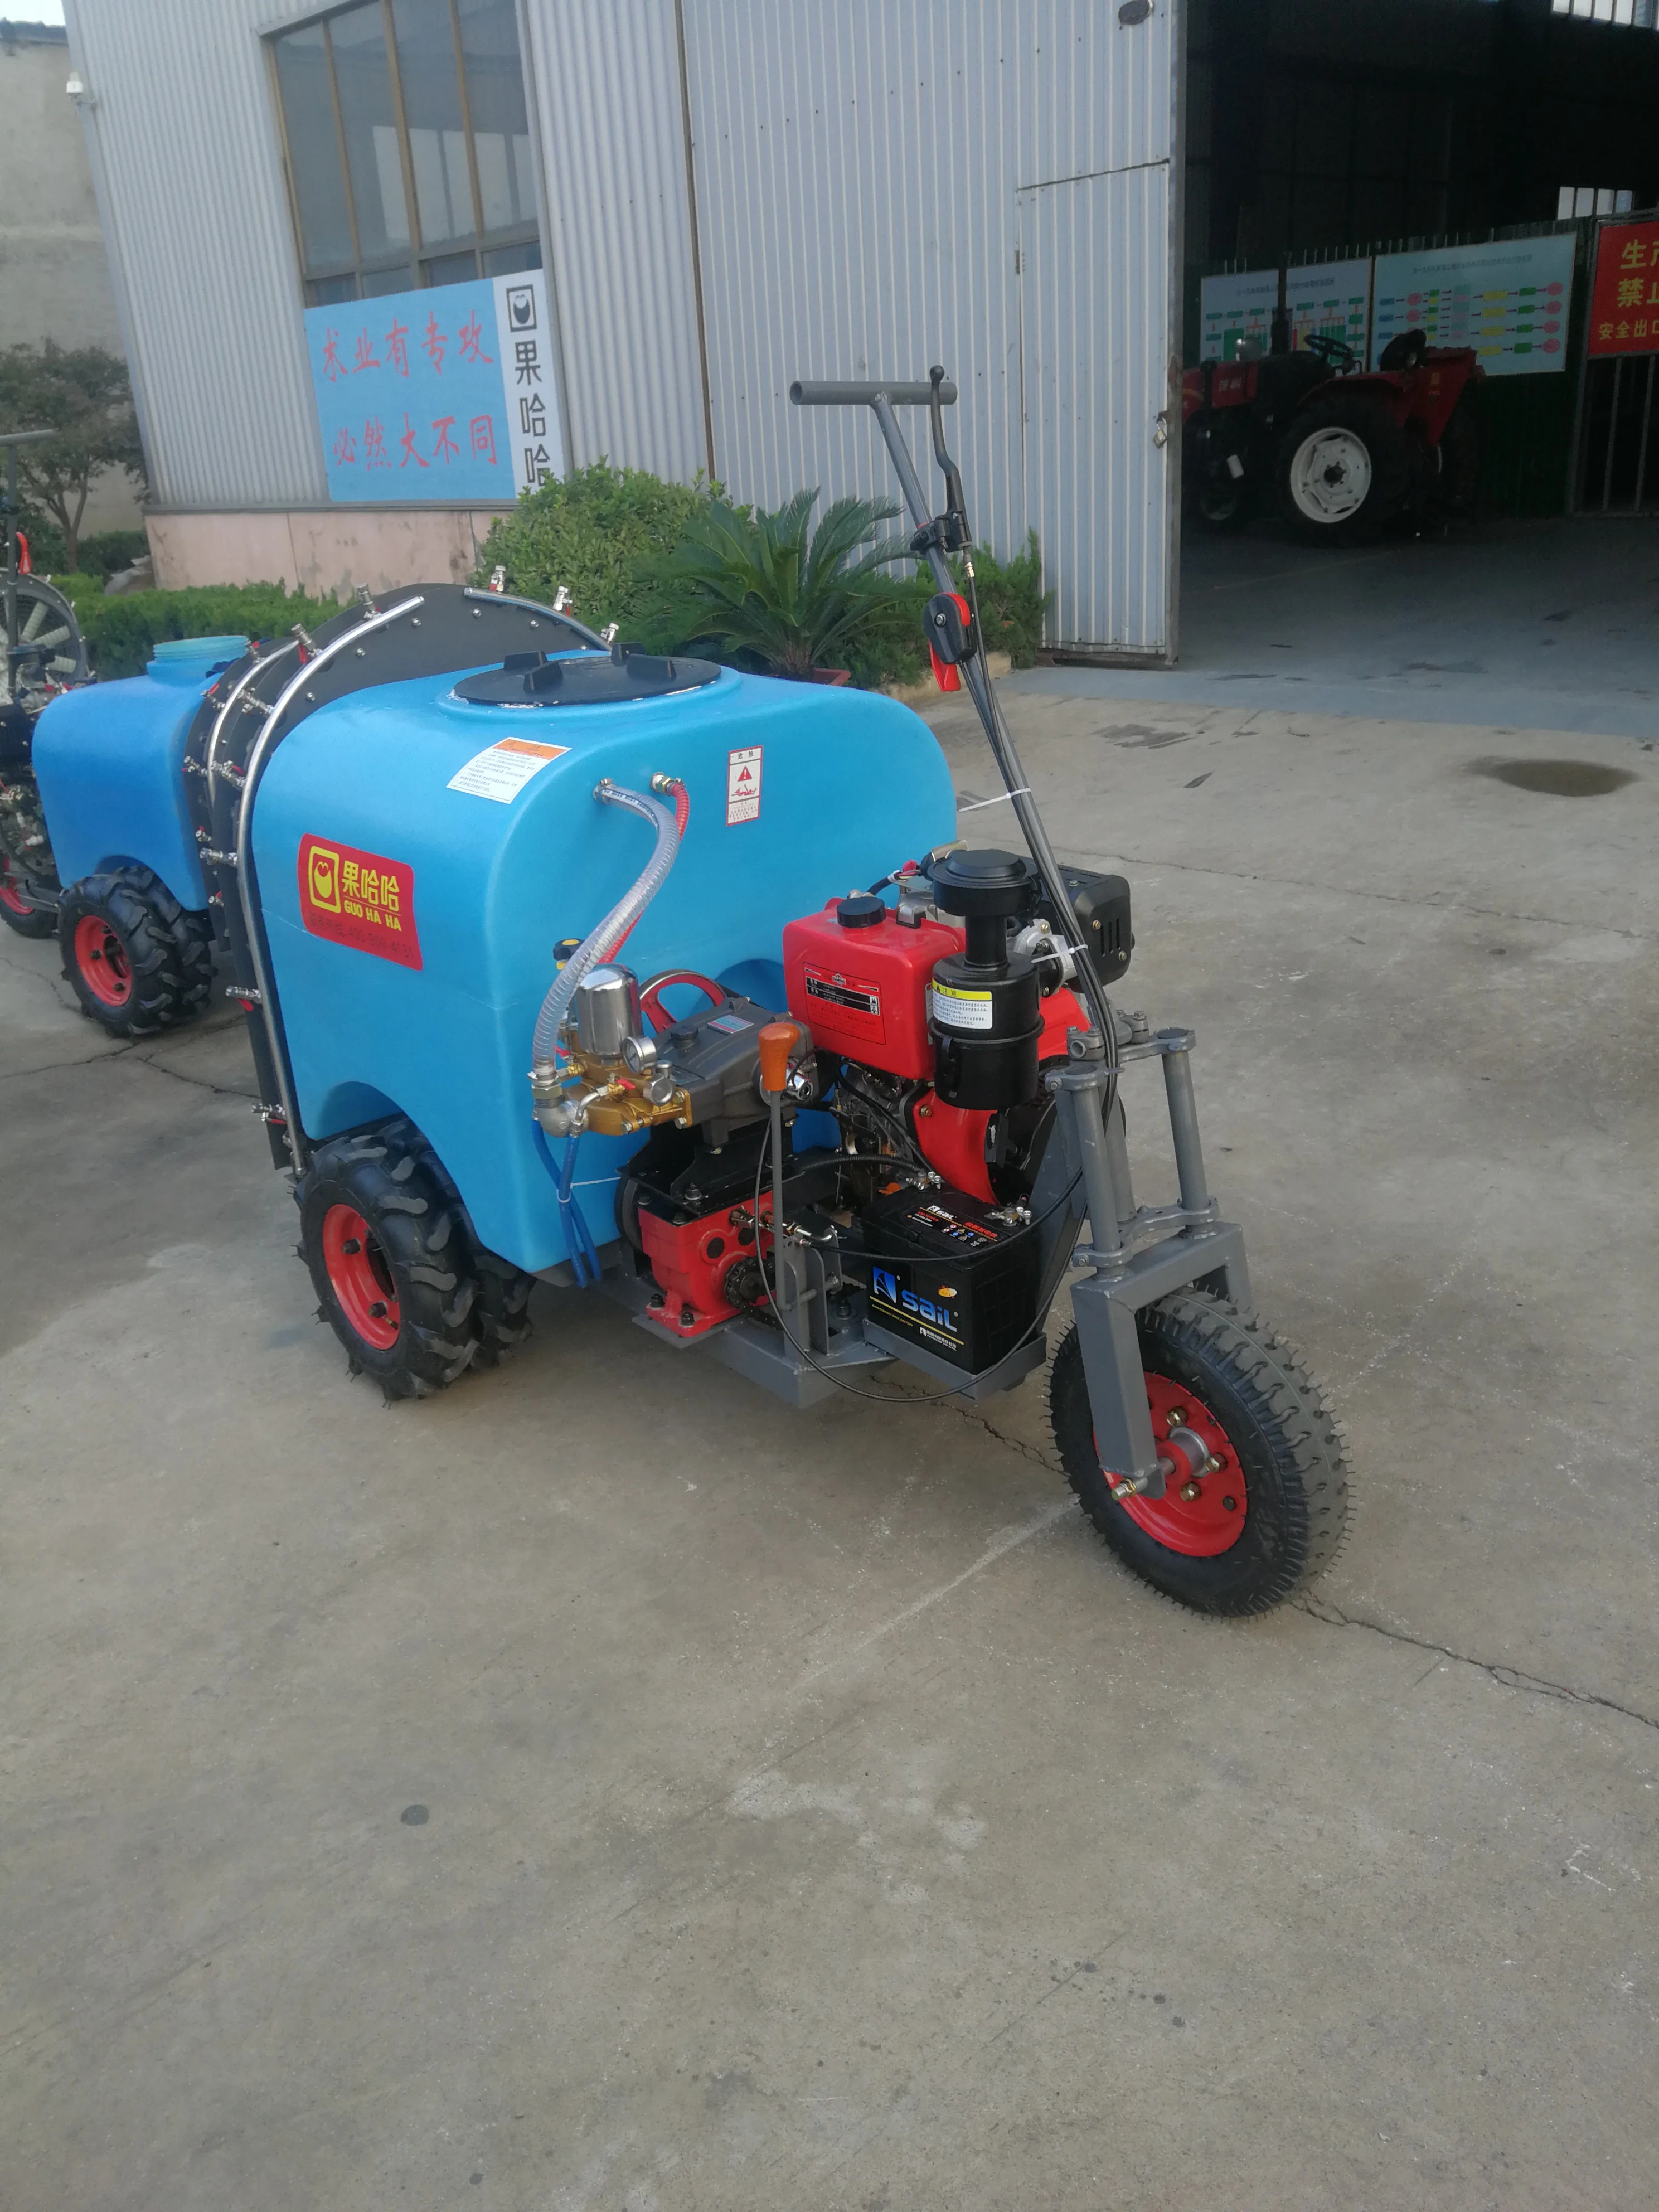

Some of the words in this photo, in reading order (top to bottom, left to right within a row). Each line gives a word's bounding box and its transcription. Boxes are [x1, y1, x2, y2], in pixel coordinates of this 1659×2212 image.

[322, 308, 494, 382] 术业有专攻
[332, 411, 498, 471] 必然大不同
[514, 339, 551, 487] 果哈哈
[341, 860, 400, 912] 果哈哈
[343, 900, 363, 918] GUO
[365, 907, 382, 925] HA
[385, 914, 402, 932] HA
